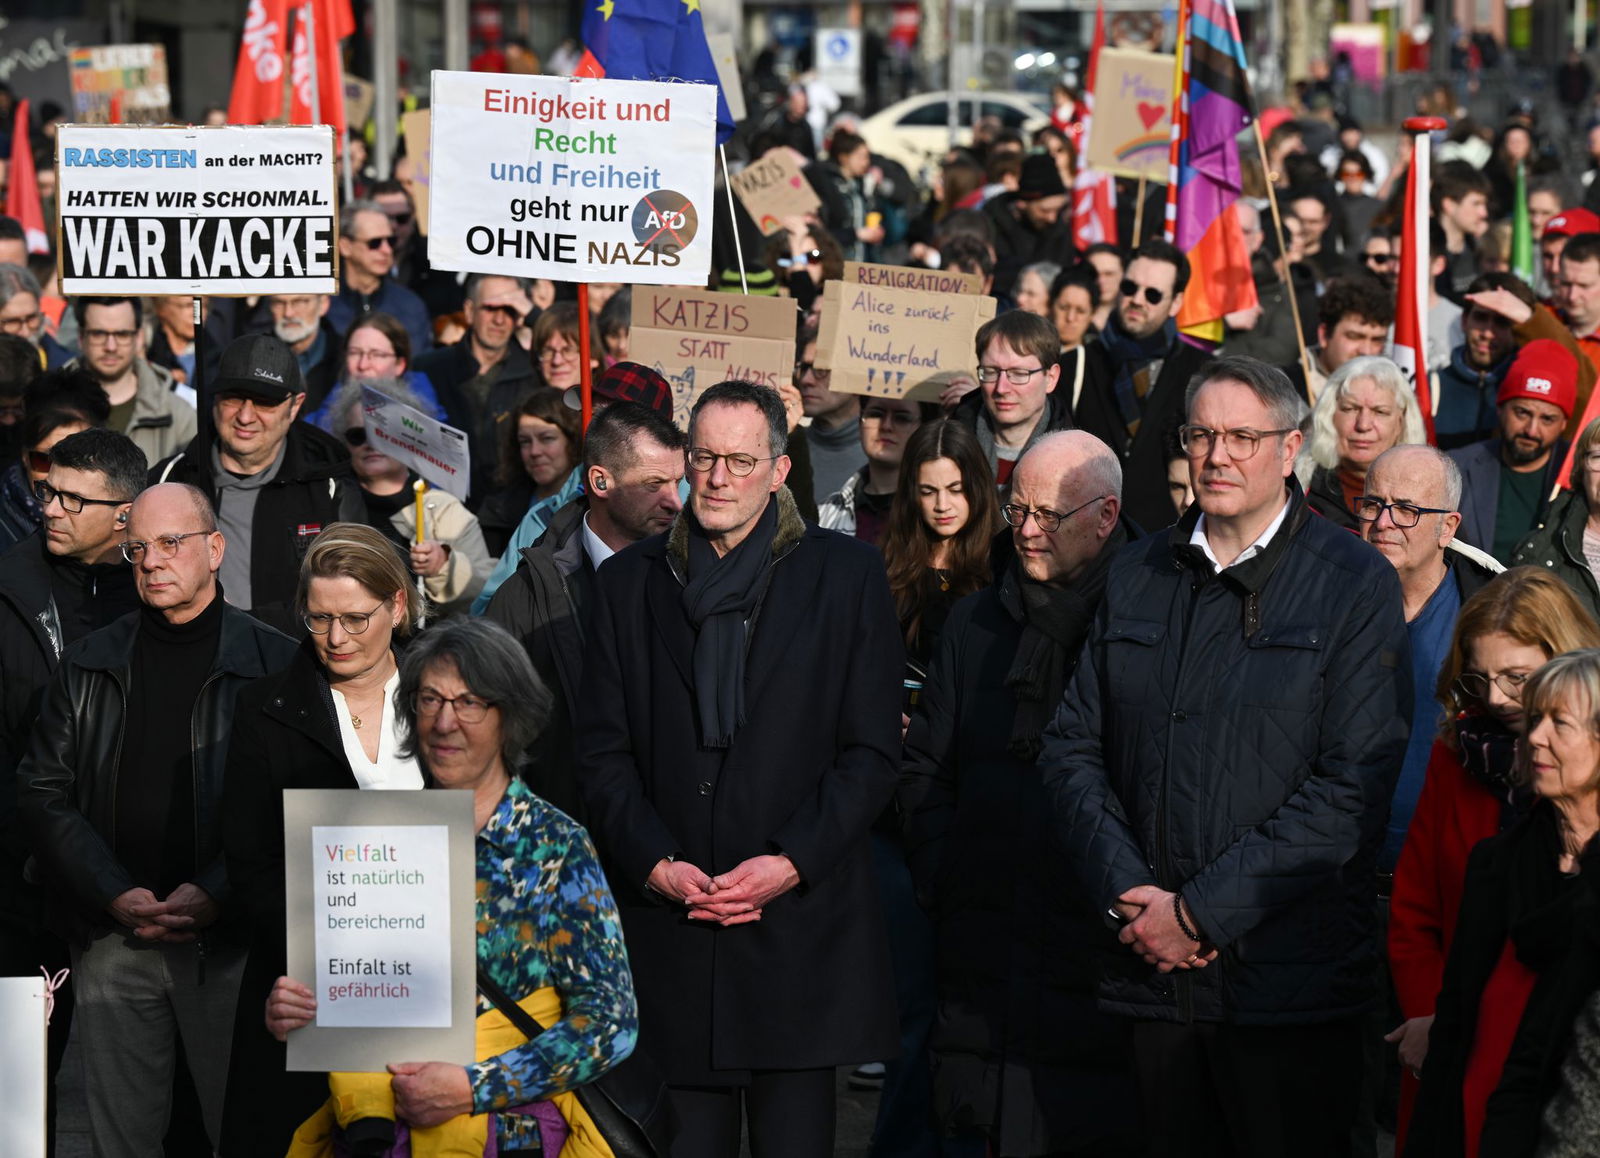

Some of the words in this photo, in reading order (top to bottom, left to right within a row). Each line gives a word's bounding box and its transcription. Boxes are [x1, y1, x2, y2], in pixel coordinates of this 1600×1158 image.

[484, 88, 606, 123] Einigkeit
[616, 99, 670, 122] und
[535, 128, 617, 154] Recht
[64, 148, 197, 168] RASSISTEN
[205, 158, 224, 167] an
[228, 154, 254, 167] der
[259, 153, 323, 167] MACHT?
[490, 161, 542, 185] und
[552, 164, 661, 190] Freiheit
[67, 190, 149, 207] HATTEN
[155, 191, 197, 208] WIR
[202, 190, 329, 208] SCHONMAL.
[510, 196, 572, 222] geht
[581, 202, 629, 223] nur
[644, 210, 686, 230] AfD
[64, 218, 167, 277] WAR
[180, 218, 332, 277] KACKE
[466, 226, 577, 263] OHNE
[588, 242, 681, 267] NAZIS
[858, 267, 968, 293] REMIGRATION:
[653, 295, 749, 333] KATZIS
[852, 291, 894, 315] Alice
[905, 304, 955, 322] zurück
[868, 319, 890, 335] ins
[677, 338, 731, 360] STATT
[848, 336, 940, 369] Wunderland
[724, 364, 778, 390] NAZIS
[1526, 376, 1552, 391] SPD
[401, 416, 425, 434] Wir
[374, 427, 457, 476] Brandmauer
[325, 844, 397, 862] Vielfalt
[327, 870, 345, 885] ist
[351, 870, 424, 885] natürlich
[327, 892, 357, 907] und
[328, 914, 425, 929] bereichernd
[328, 958, 387, 975] Einfalt
[393, 960, 412, 975] ist
[328, 982, 410, 1002] gefährlich
